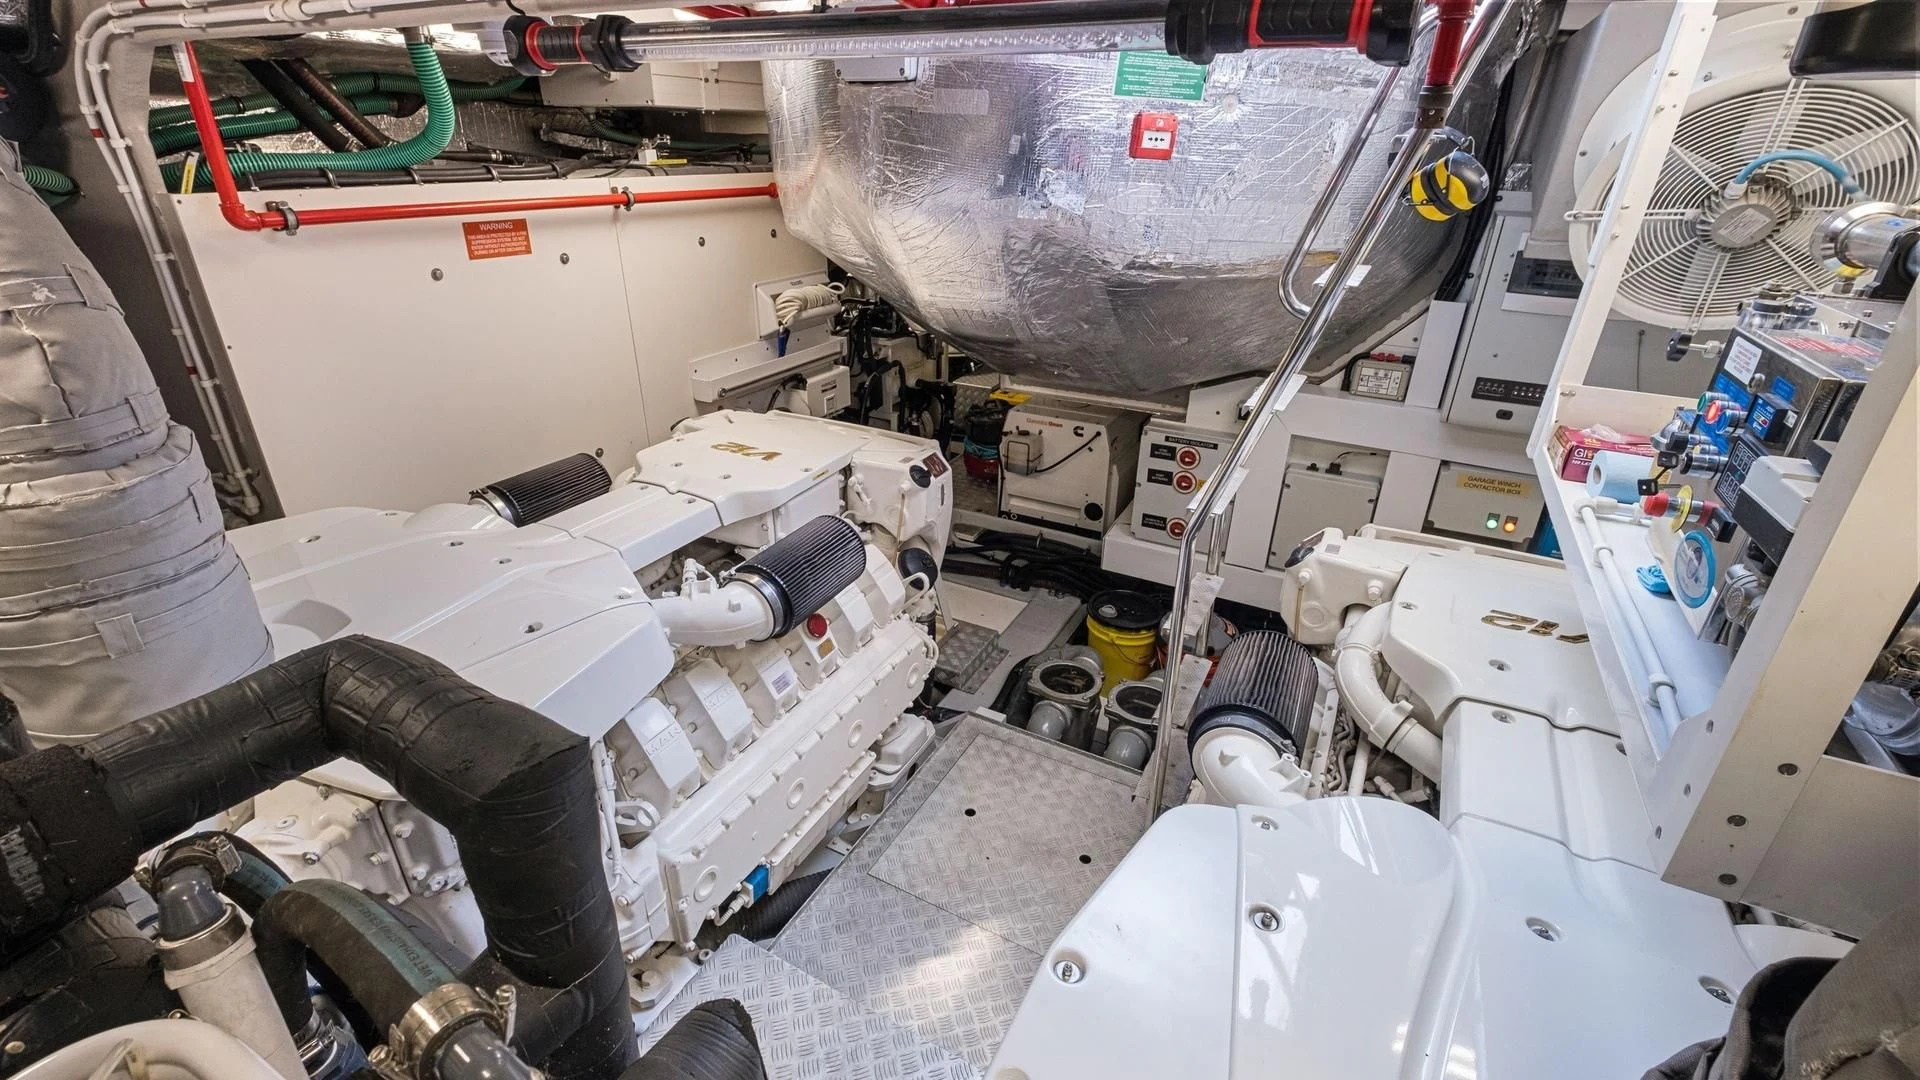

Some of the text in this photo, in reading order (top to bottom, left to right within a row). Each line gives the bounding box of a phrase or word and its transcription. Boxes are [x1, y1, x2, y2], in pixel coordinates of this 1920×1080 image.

[479, 222, 513, 231] WARNING
[1168, 437, 1190, 445] BATTERY
[1467, 475, 1521, 488] GARAGE WINCH
[1463, 482, 1506, 493] CONTACTOR
